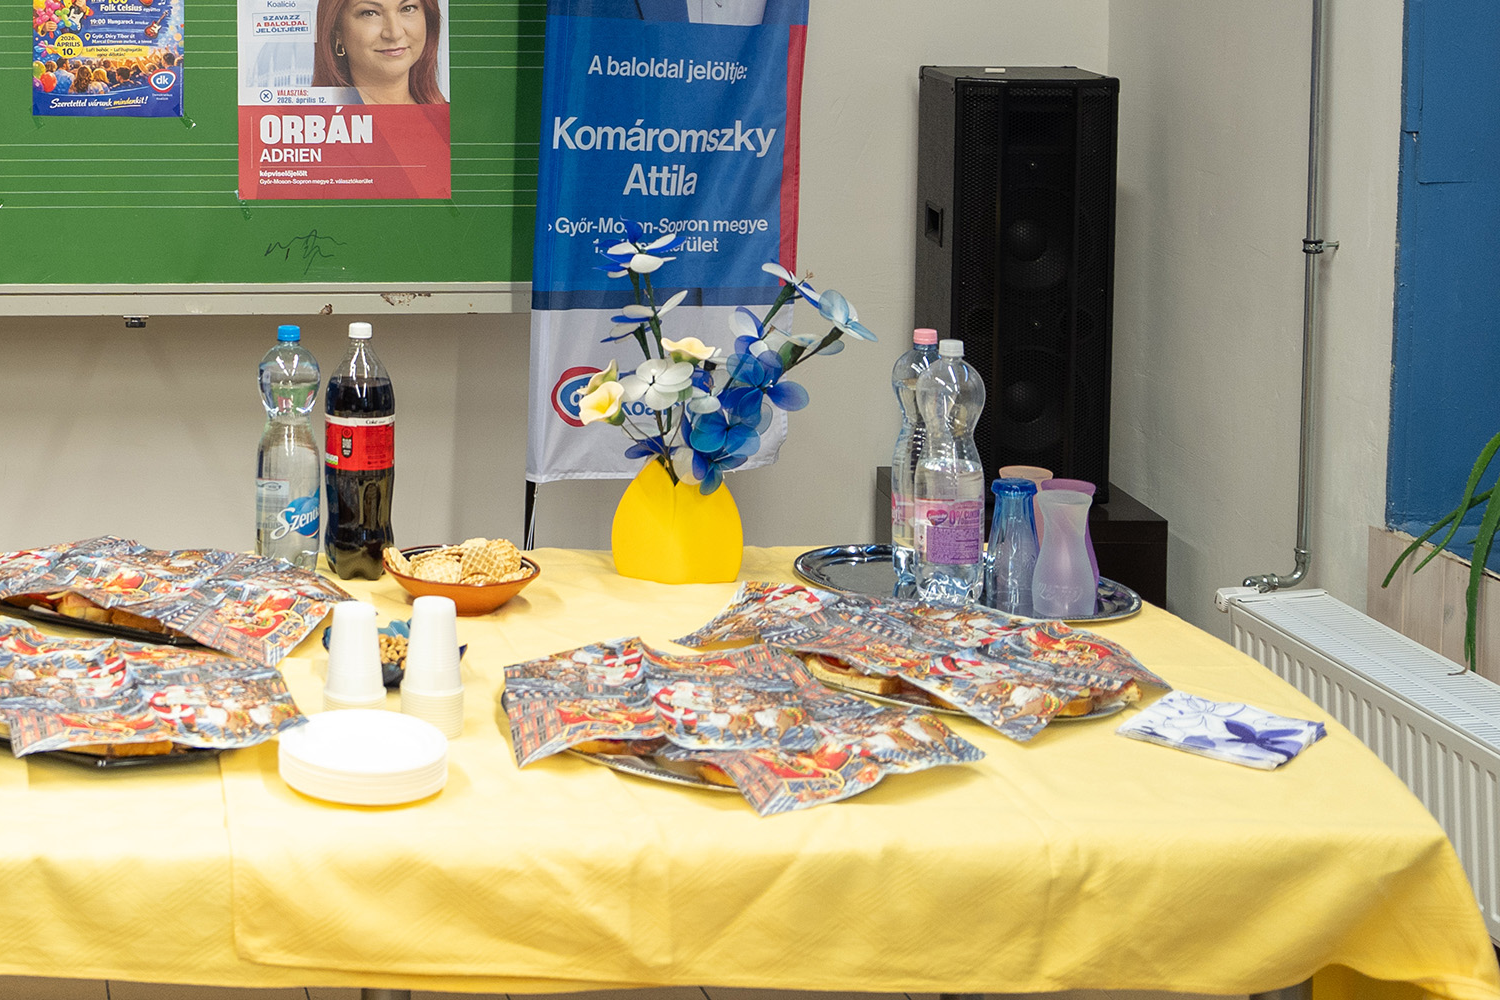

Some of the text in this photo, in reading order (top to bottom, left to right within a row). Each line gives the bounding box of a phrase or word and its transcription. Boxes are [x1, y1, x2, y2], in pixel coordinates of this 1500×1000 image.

[588, 55, 747, 84] A baloldal jelöltje:
[156, 75, 169, 85] dk
[50, 98, 86, 108] Szeretettel
[277, 89, 309, 97] VÁLASZTÁS:
[260, 106, 373, 144] ORBÁN
[553, 117, 776, 157] Komáromszky
[260, 148, 321, 162] ADRIEN
[623, 163, 698, 196] Attila
[555, 216, 768, 236] Győr-Mon-Sopron megye
